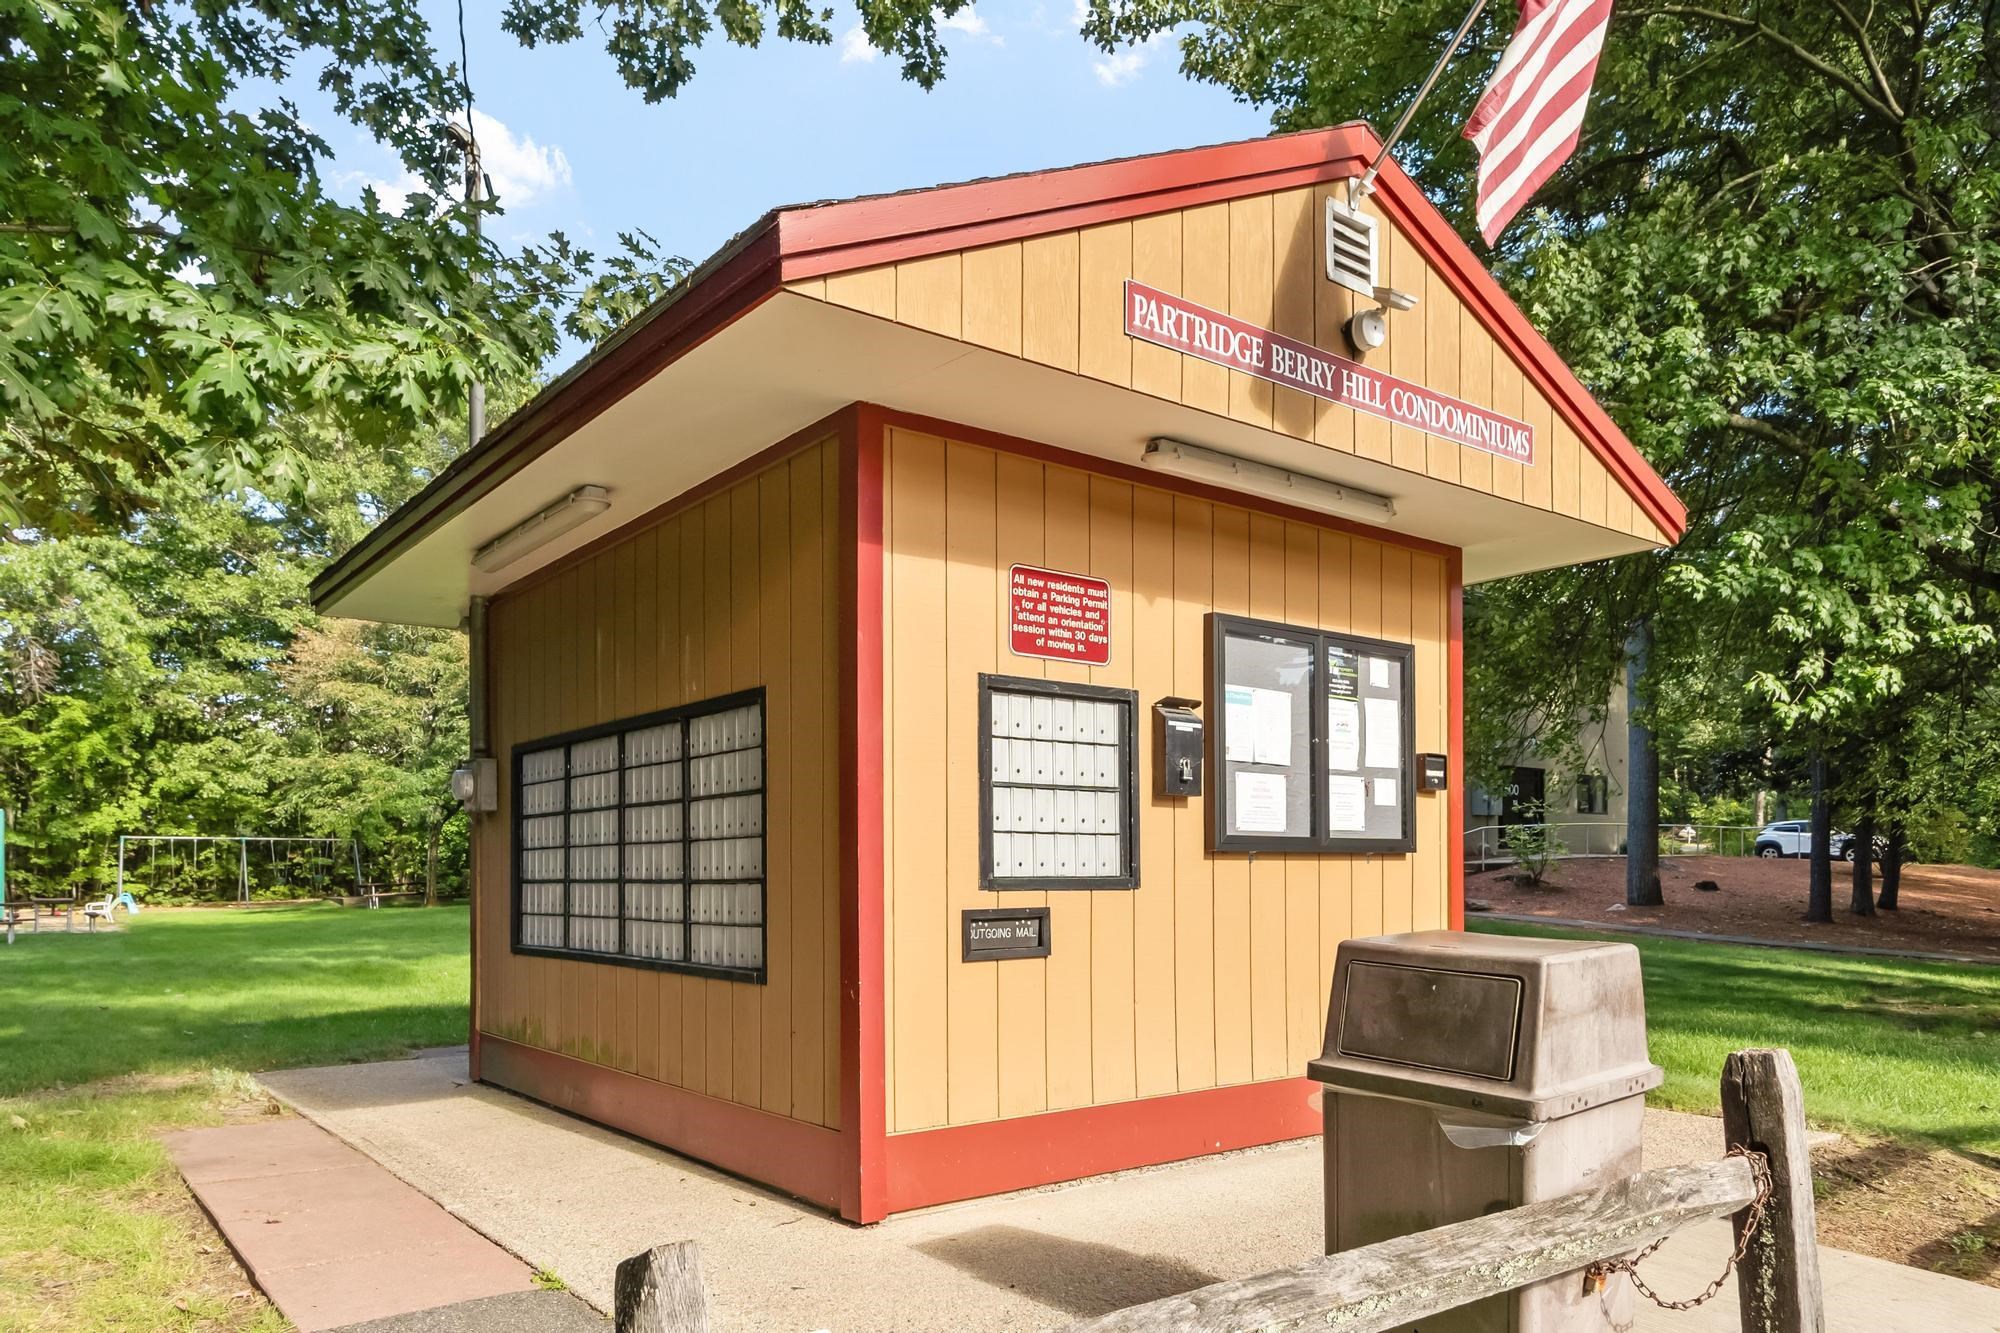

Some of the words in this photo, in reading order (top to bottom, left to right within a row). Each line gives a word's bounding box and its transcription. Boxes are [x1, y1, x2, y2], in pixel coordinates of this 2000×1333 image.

[1132, 293, 1265, 369] PARTRIDGE
[1270, 343, 1337, 392] BERRY
[1341, 369, 1387, 412] HILL
[1390, 388, 1530, 457] CONDOMINIUMS
[1014, 574, 1024, 584] All
[1027, 577, 1045, 588] new
[1048, 581, 1085, 594] residents
[1087, 588, 1108, 598] must
[1012, 587, 1039, 599] obtain
[1042, 592, 1048, 600] a
[1050, 592, 1080, 606] Parking
[1082, 597, 1108, 610] Permit
[1021, 599, 1034, 610] for
[1037, 602, 1047, 612] all
[1049, 604, 1082, 617] vehicles
[1085, 610, 1100, 620] and
[1018, 612, 1045, 623] attend
[1048, 617, 1058, 625] an
[1061, 619, 1103, 631] orientation
[1013, 623, 1046, 635] session
[1048, 628, 1072, 639] within
[1074, 631, 1086, 641] 30
[1088, 632, 1108, 644] days
[1035, 637, 1045, 647] of
[1047, 641, 1075, 652] moving
[1077, 642, 1087, 653] in.
[1016, 927, 1036, 937] MAIL
